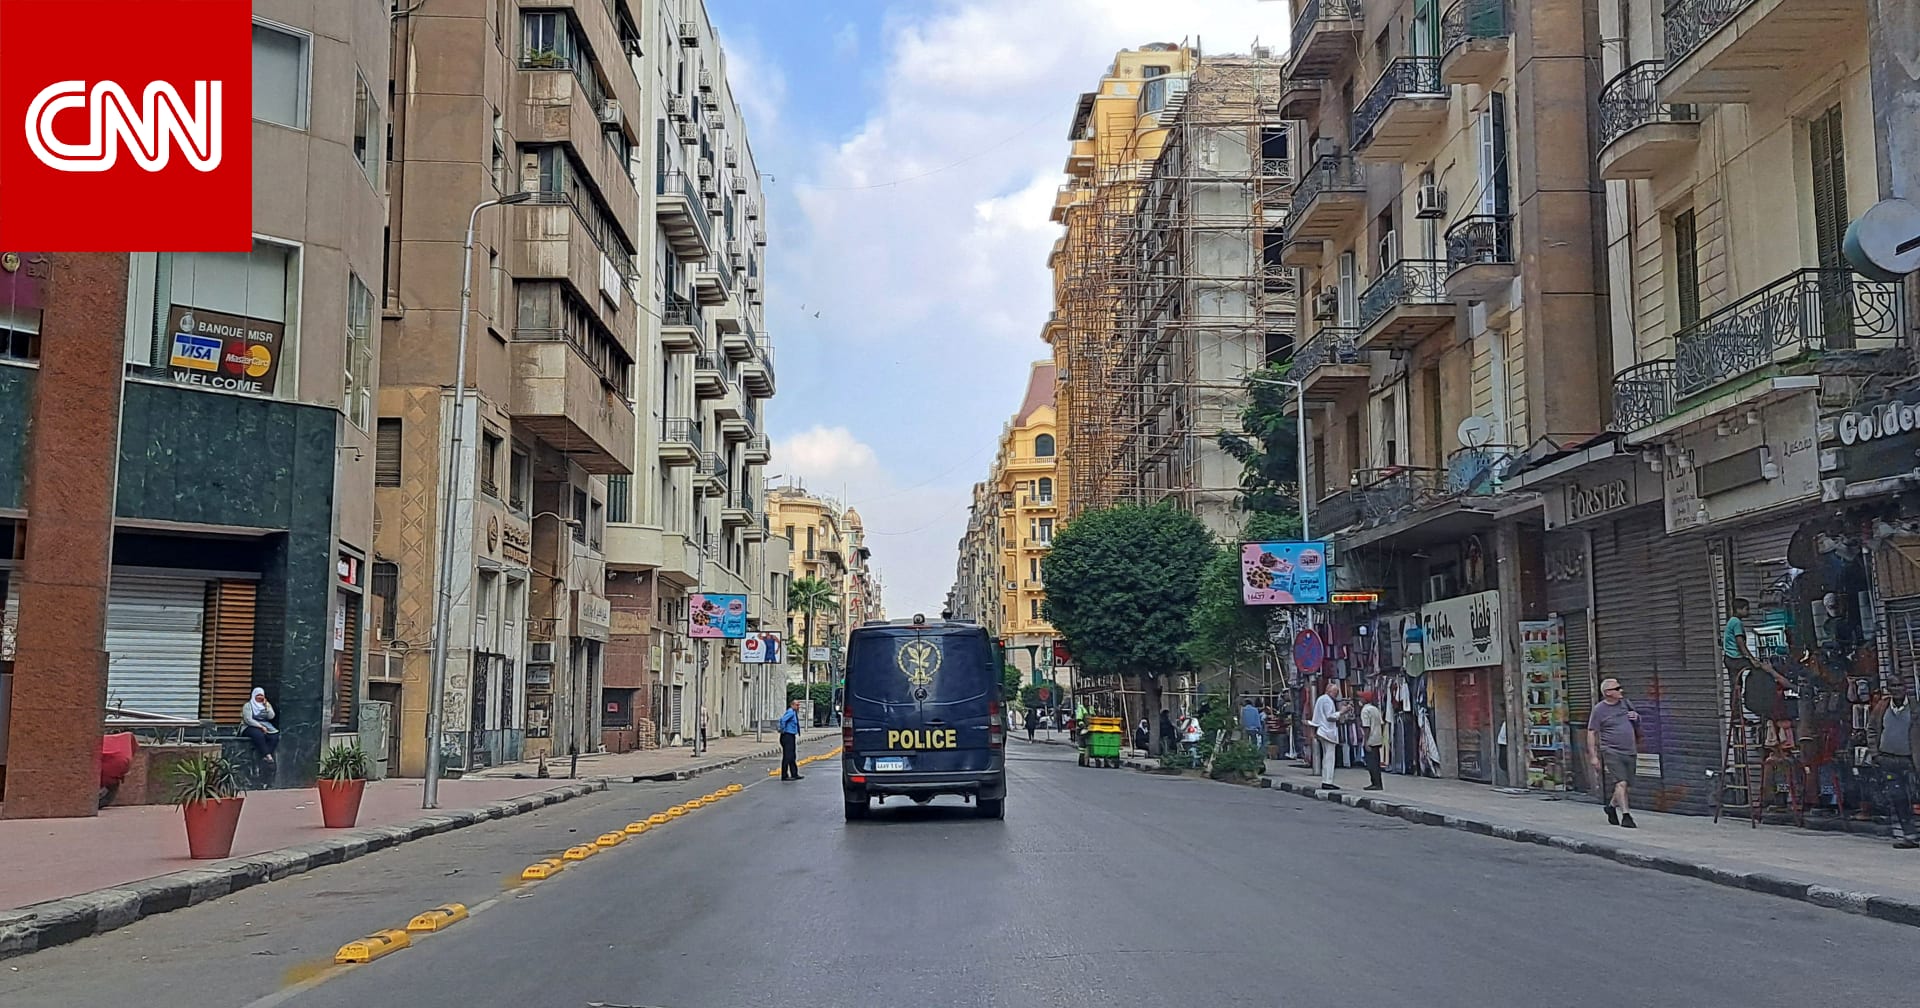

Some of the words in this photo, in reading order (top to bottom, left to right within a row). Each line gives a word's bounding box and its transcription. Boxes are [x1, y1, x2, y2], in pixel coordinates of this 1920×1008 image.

[198, 321, 244, 338] BANQUE
[247, 330, 273, 343] MISR
[181, 344, 212, 360] VISA
[225, 353, 270, 367] MasterCard
[173, 371, 263, 393] WELCOME
[888, 729, 957, 750] POLICE
